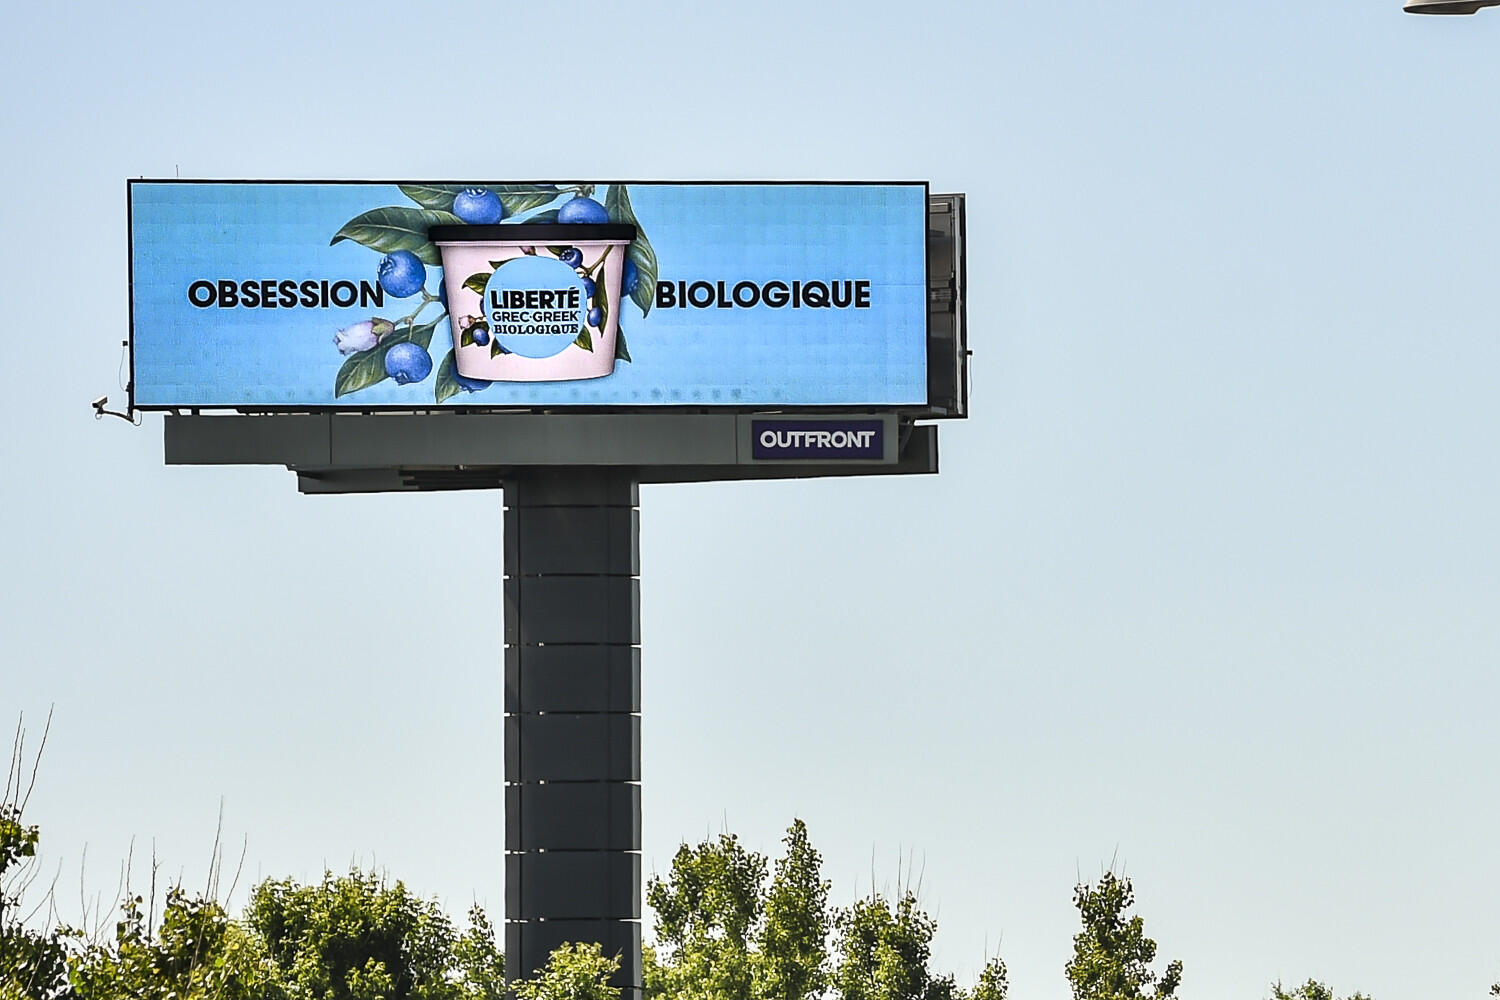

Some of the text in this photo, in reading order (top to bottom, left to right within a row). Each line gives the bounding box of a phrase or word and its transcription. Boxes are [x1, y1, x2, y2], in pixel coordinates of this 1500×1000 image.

[189, 280, 871, 310] OBSESSION BIOLOGIQUE
[491, 287, 580, 309] LIBERTÉ
[494, 323, 579, 336] BIOLOGIQUE
[760, 430, 876, 448] OUTFRONT
